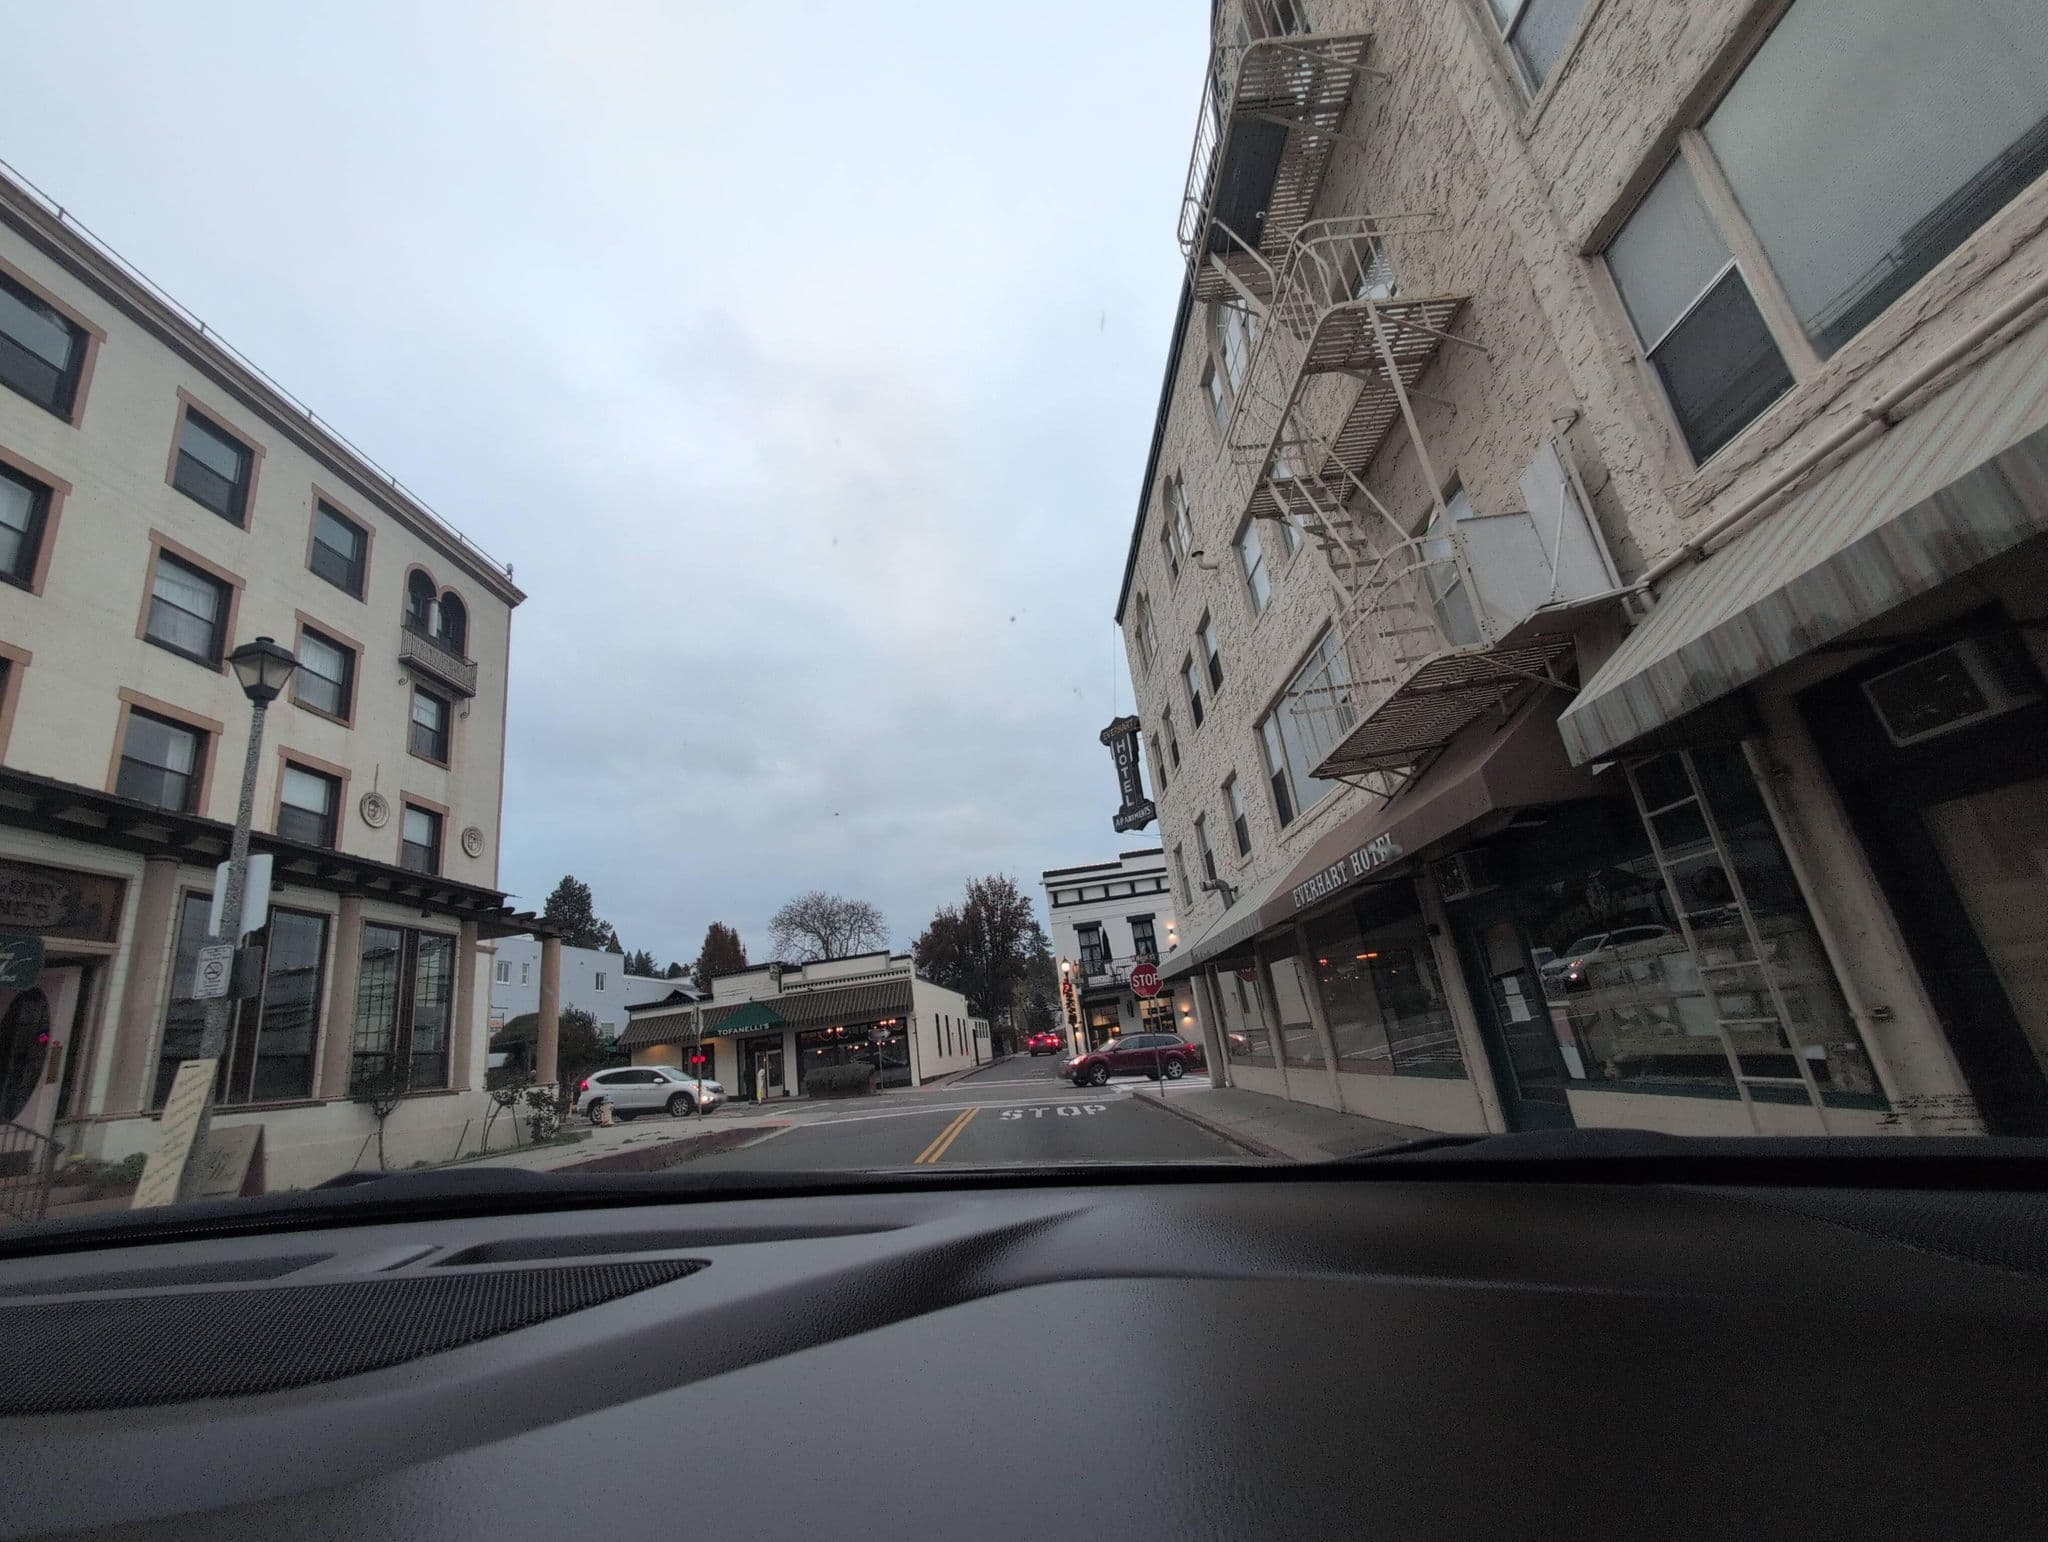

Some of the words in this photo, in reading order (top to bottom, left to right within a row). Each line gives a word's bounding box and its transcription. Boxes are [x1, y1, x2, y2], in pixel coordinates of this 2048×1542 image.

[1116, 738, 1135, 808] HOTEL
[1115, 804, 1153, 827] APARTMENTS
[1293, 860, 1348, 908] EVERHART
[717, 1023, 770, 1036] TOFANELLI'S
[1000, 1104, 1107, 1121] STOP
